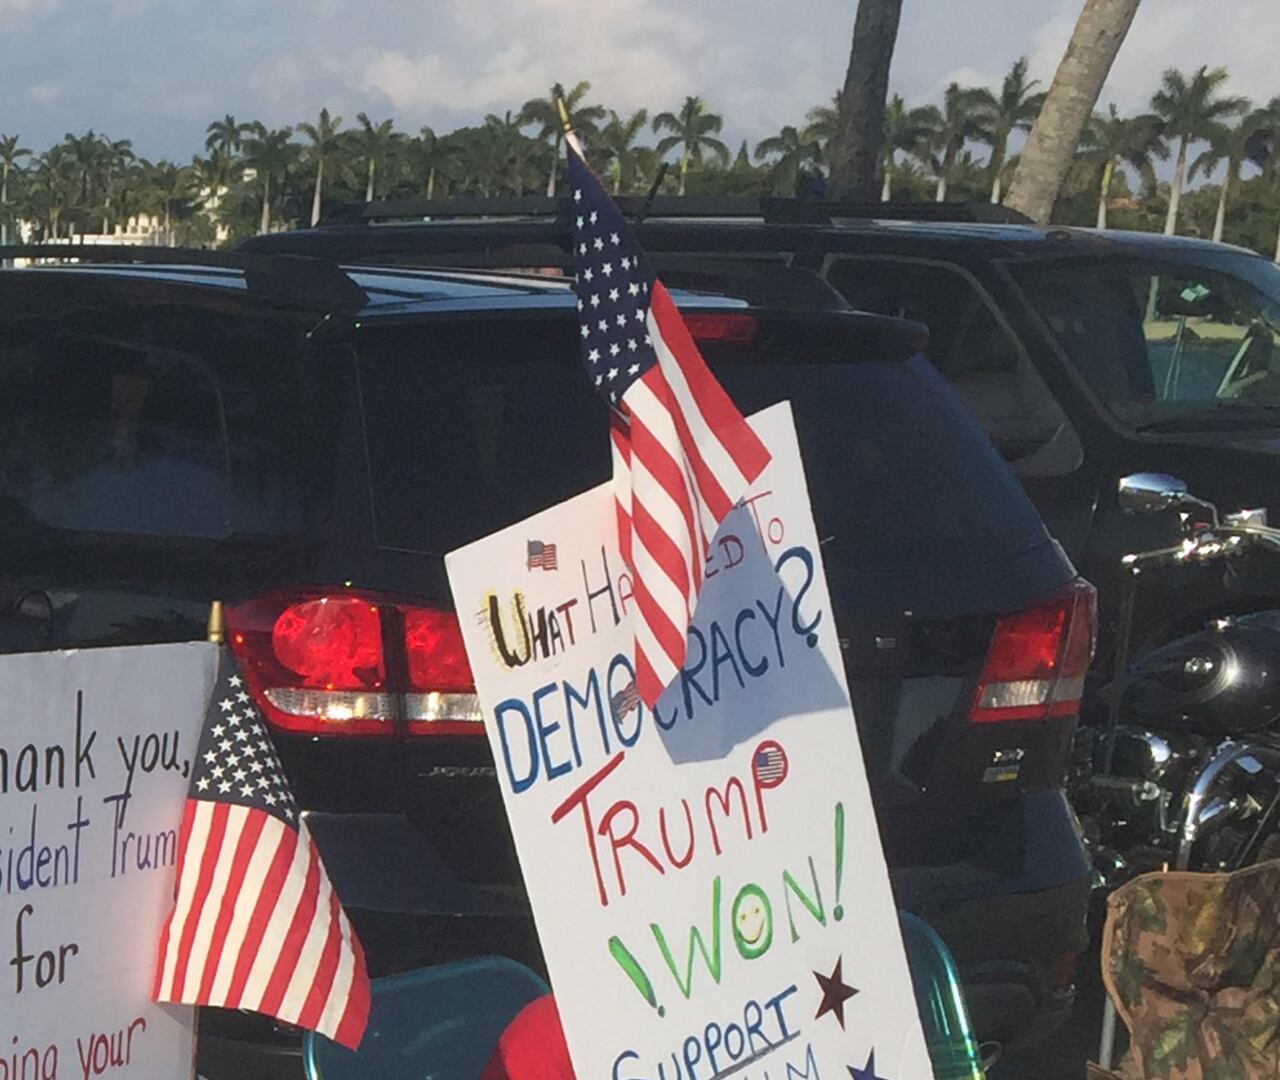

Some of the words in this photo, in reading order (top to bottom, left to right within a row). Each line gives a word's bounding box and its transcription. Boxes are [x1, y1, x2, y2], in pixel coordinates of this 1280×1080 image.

[117, 728, 191, 828] you,
[551, 740, 789, 907] TRUMP
[102, 793, 181, 879] Trum
[9, 904, 79, 994] for
